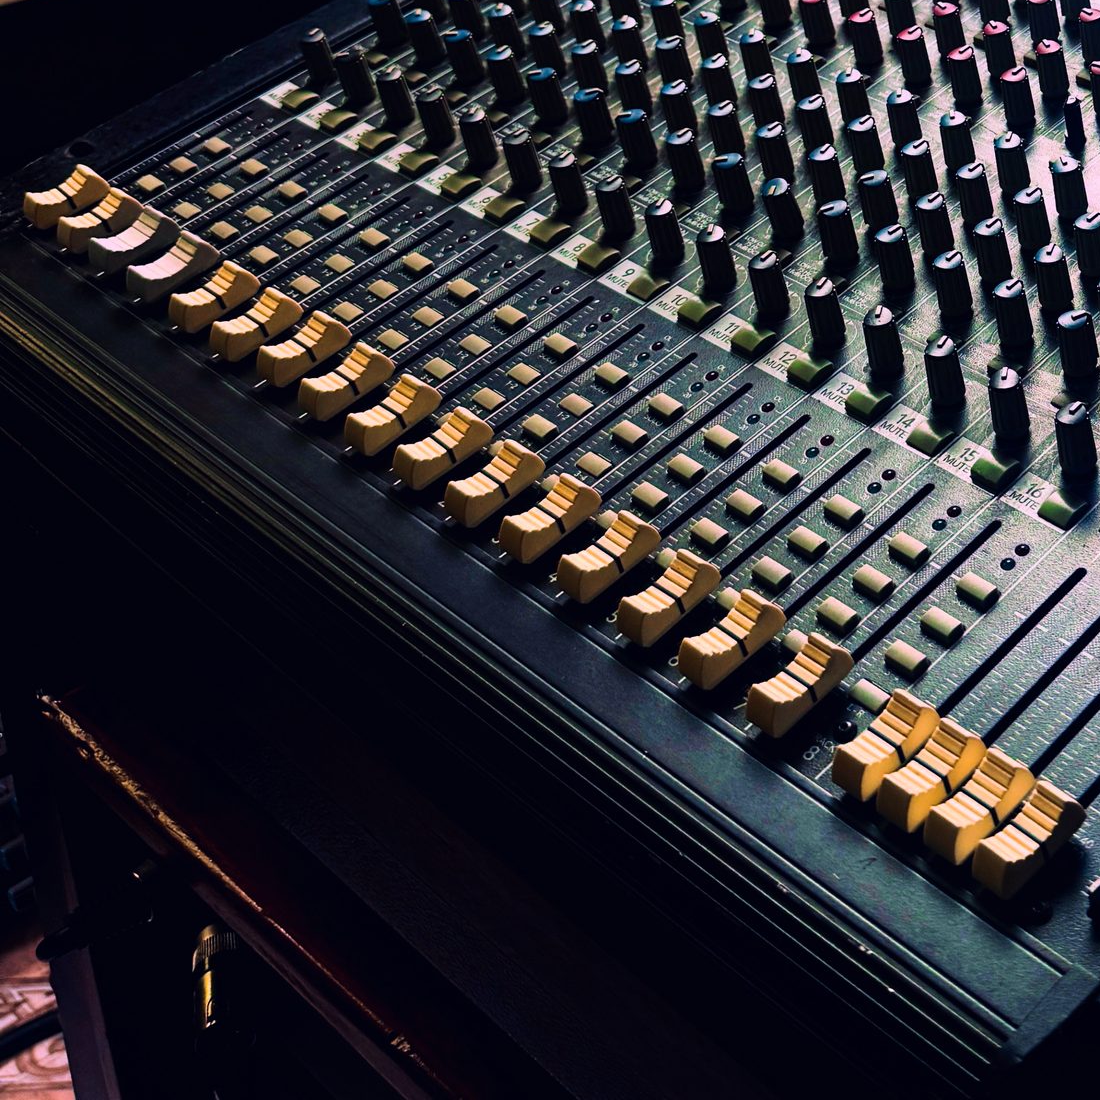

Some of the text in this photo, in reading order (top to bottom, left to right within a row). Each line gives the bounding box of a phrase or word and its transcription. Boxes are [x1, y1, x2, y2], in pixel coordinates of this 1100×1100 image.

[573, 243, 586, 252] 8
[622, 268, 636, 278] 9
[604, 273, 629, 289] MUTE
[724, 321, 741, 334] 11
[778, 351, 797, 364] 12
[837, 382, 855, 395] 13
[820, 388, 846, 406] MUTE
[898, 413, 916, 428] 14
[879, 421, 907, 439] MUTE
[959, 447, 979, 463] 15
[943, 454, 972, 474] MUTE
[1025, 483, 1043, 499] 16
[1008, 490, 1038, 510] MUTE
[1080, 836, 1095, 849] 40
